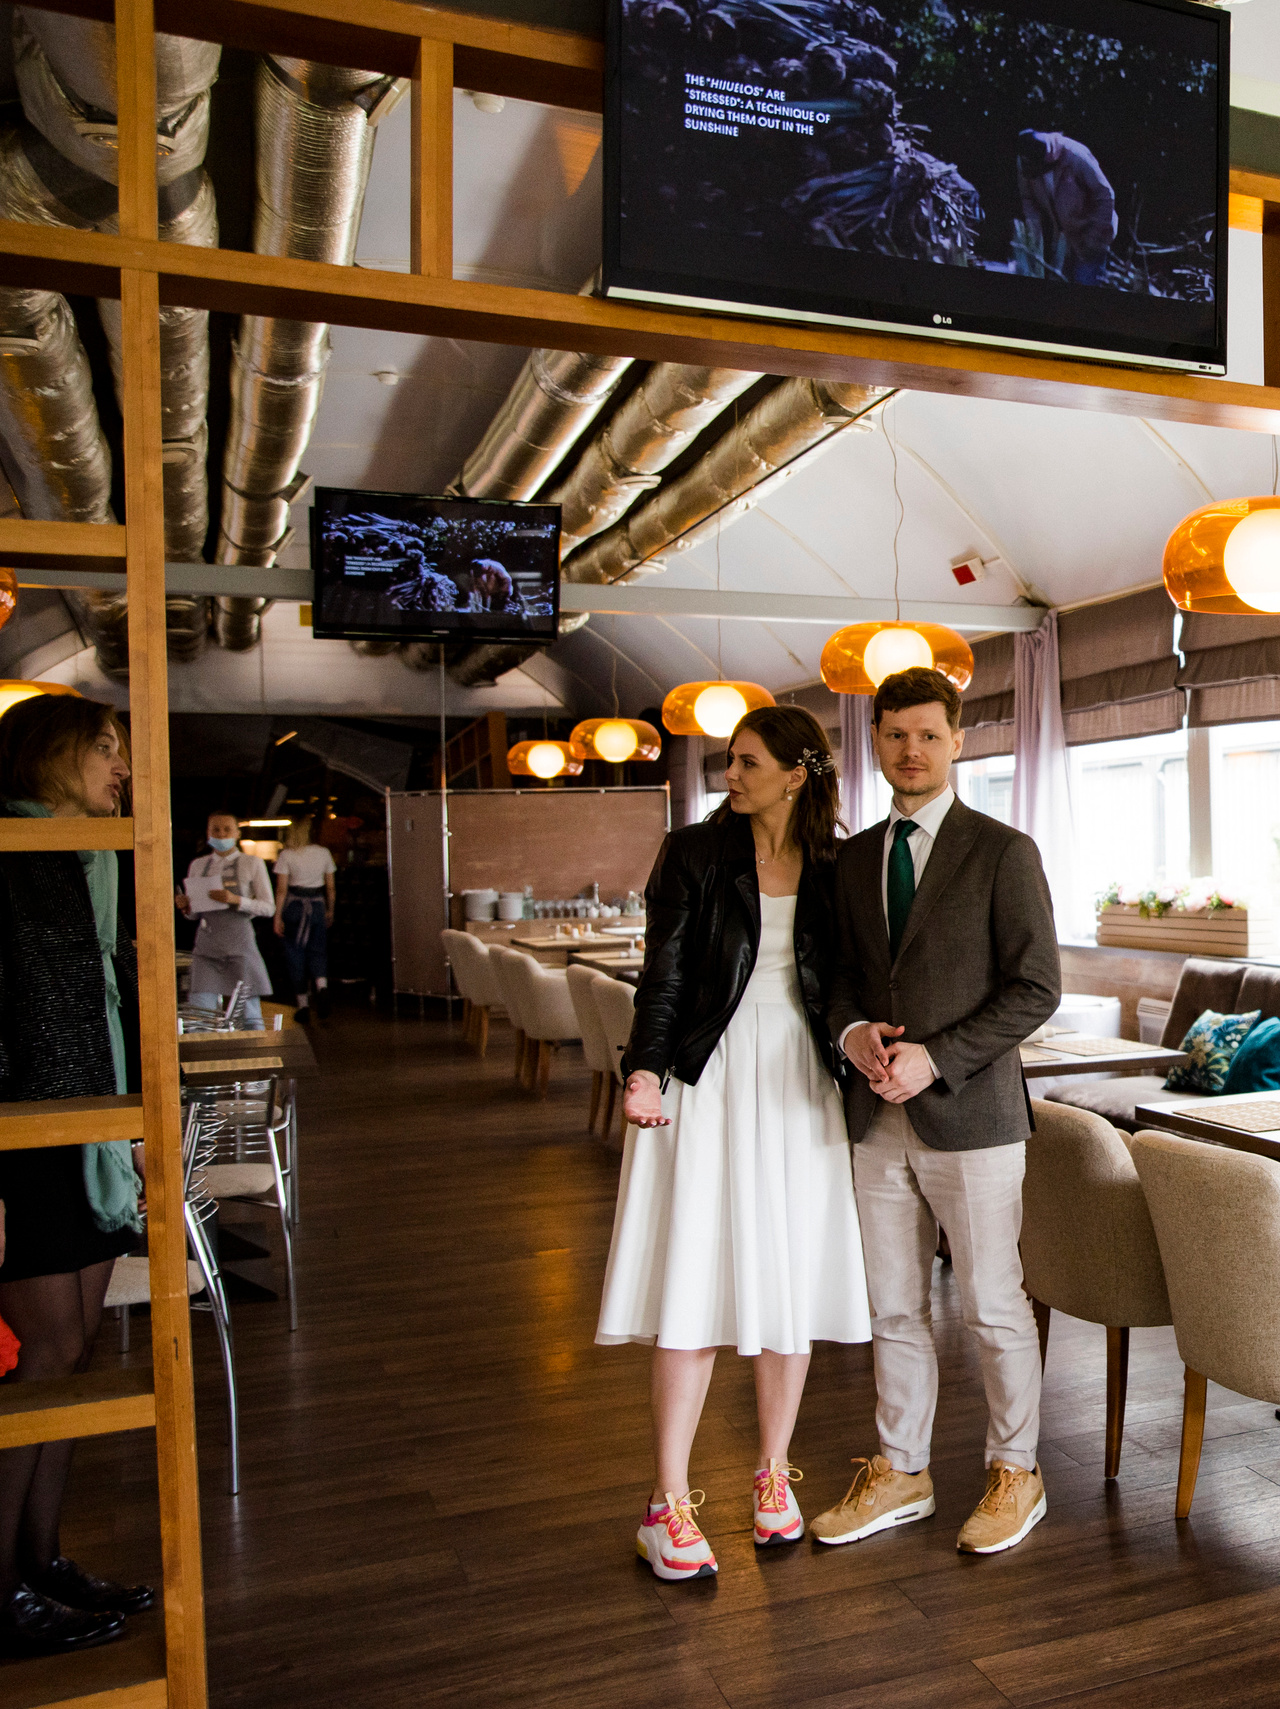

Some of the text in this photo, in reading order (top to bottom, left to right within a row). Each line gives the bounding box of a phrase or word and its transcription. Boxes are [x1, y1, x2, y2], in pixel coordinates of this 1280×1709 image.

[685, 73, 705, 86] THE
[765, 89, 786, 101] ARE
[685, 103, 814, 136] DRYING THEM OUT IN THE
[745, 100, 754, 110] A
[756, 102, 815, 121] TECHNIQUE
[816, 112, 831, 124] OF
[684, 118, 739, 137] SUNSHINE
